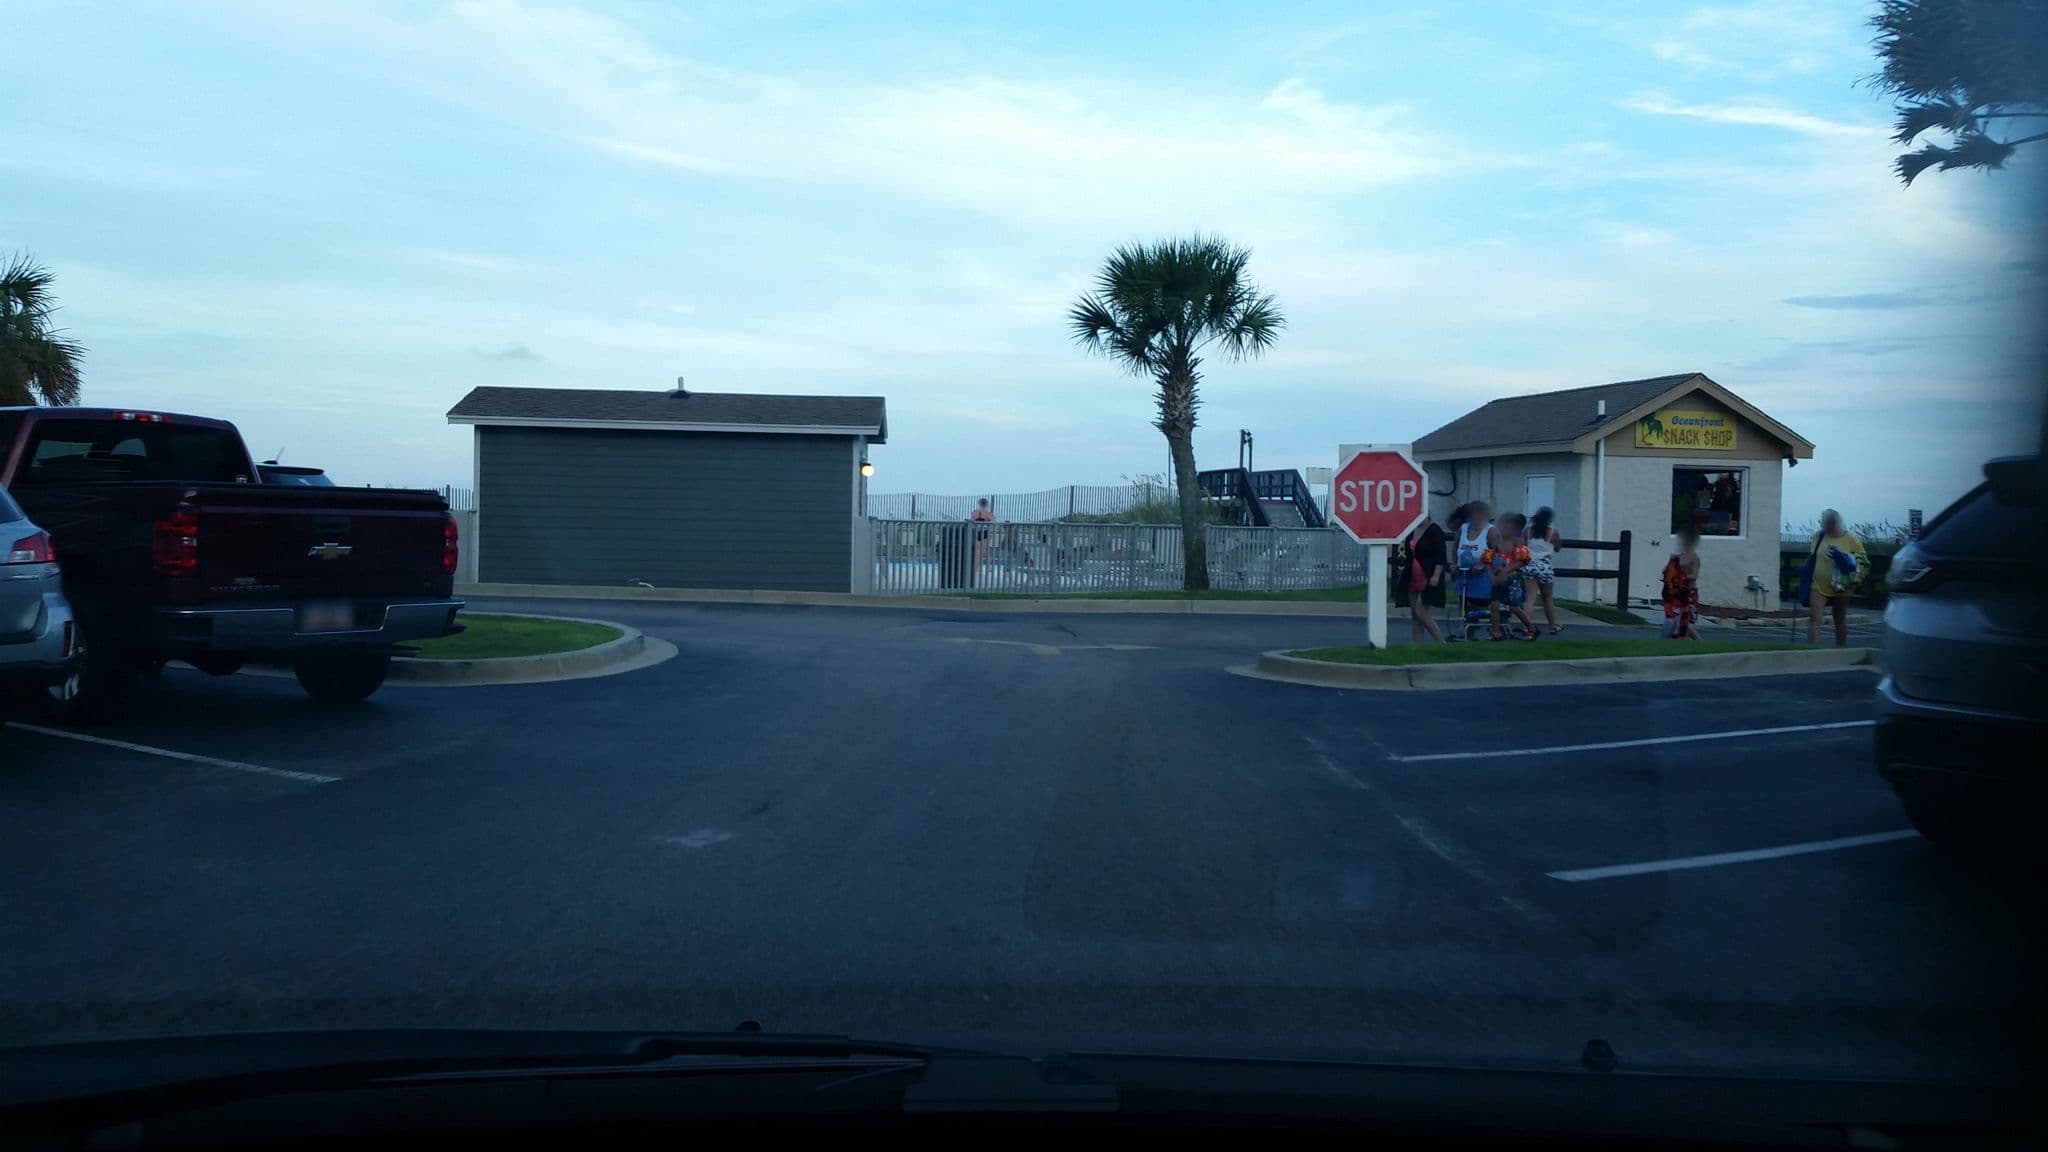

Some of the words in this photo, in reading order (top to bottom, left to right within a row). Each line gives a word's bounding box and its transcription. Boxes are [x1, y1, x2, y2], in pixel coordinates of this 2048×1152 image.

[1671, 415, 1724, 428] Oceanfront
[1663, 429, 1700, 446] SNACK
[1704, 430, 1733, 447] SHOP
[1339, 479, 1417, 513] STOP
